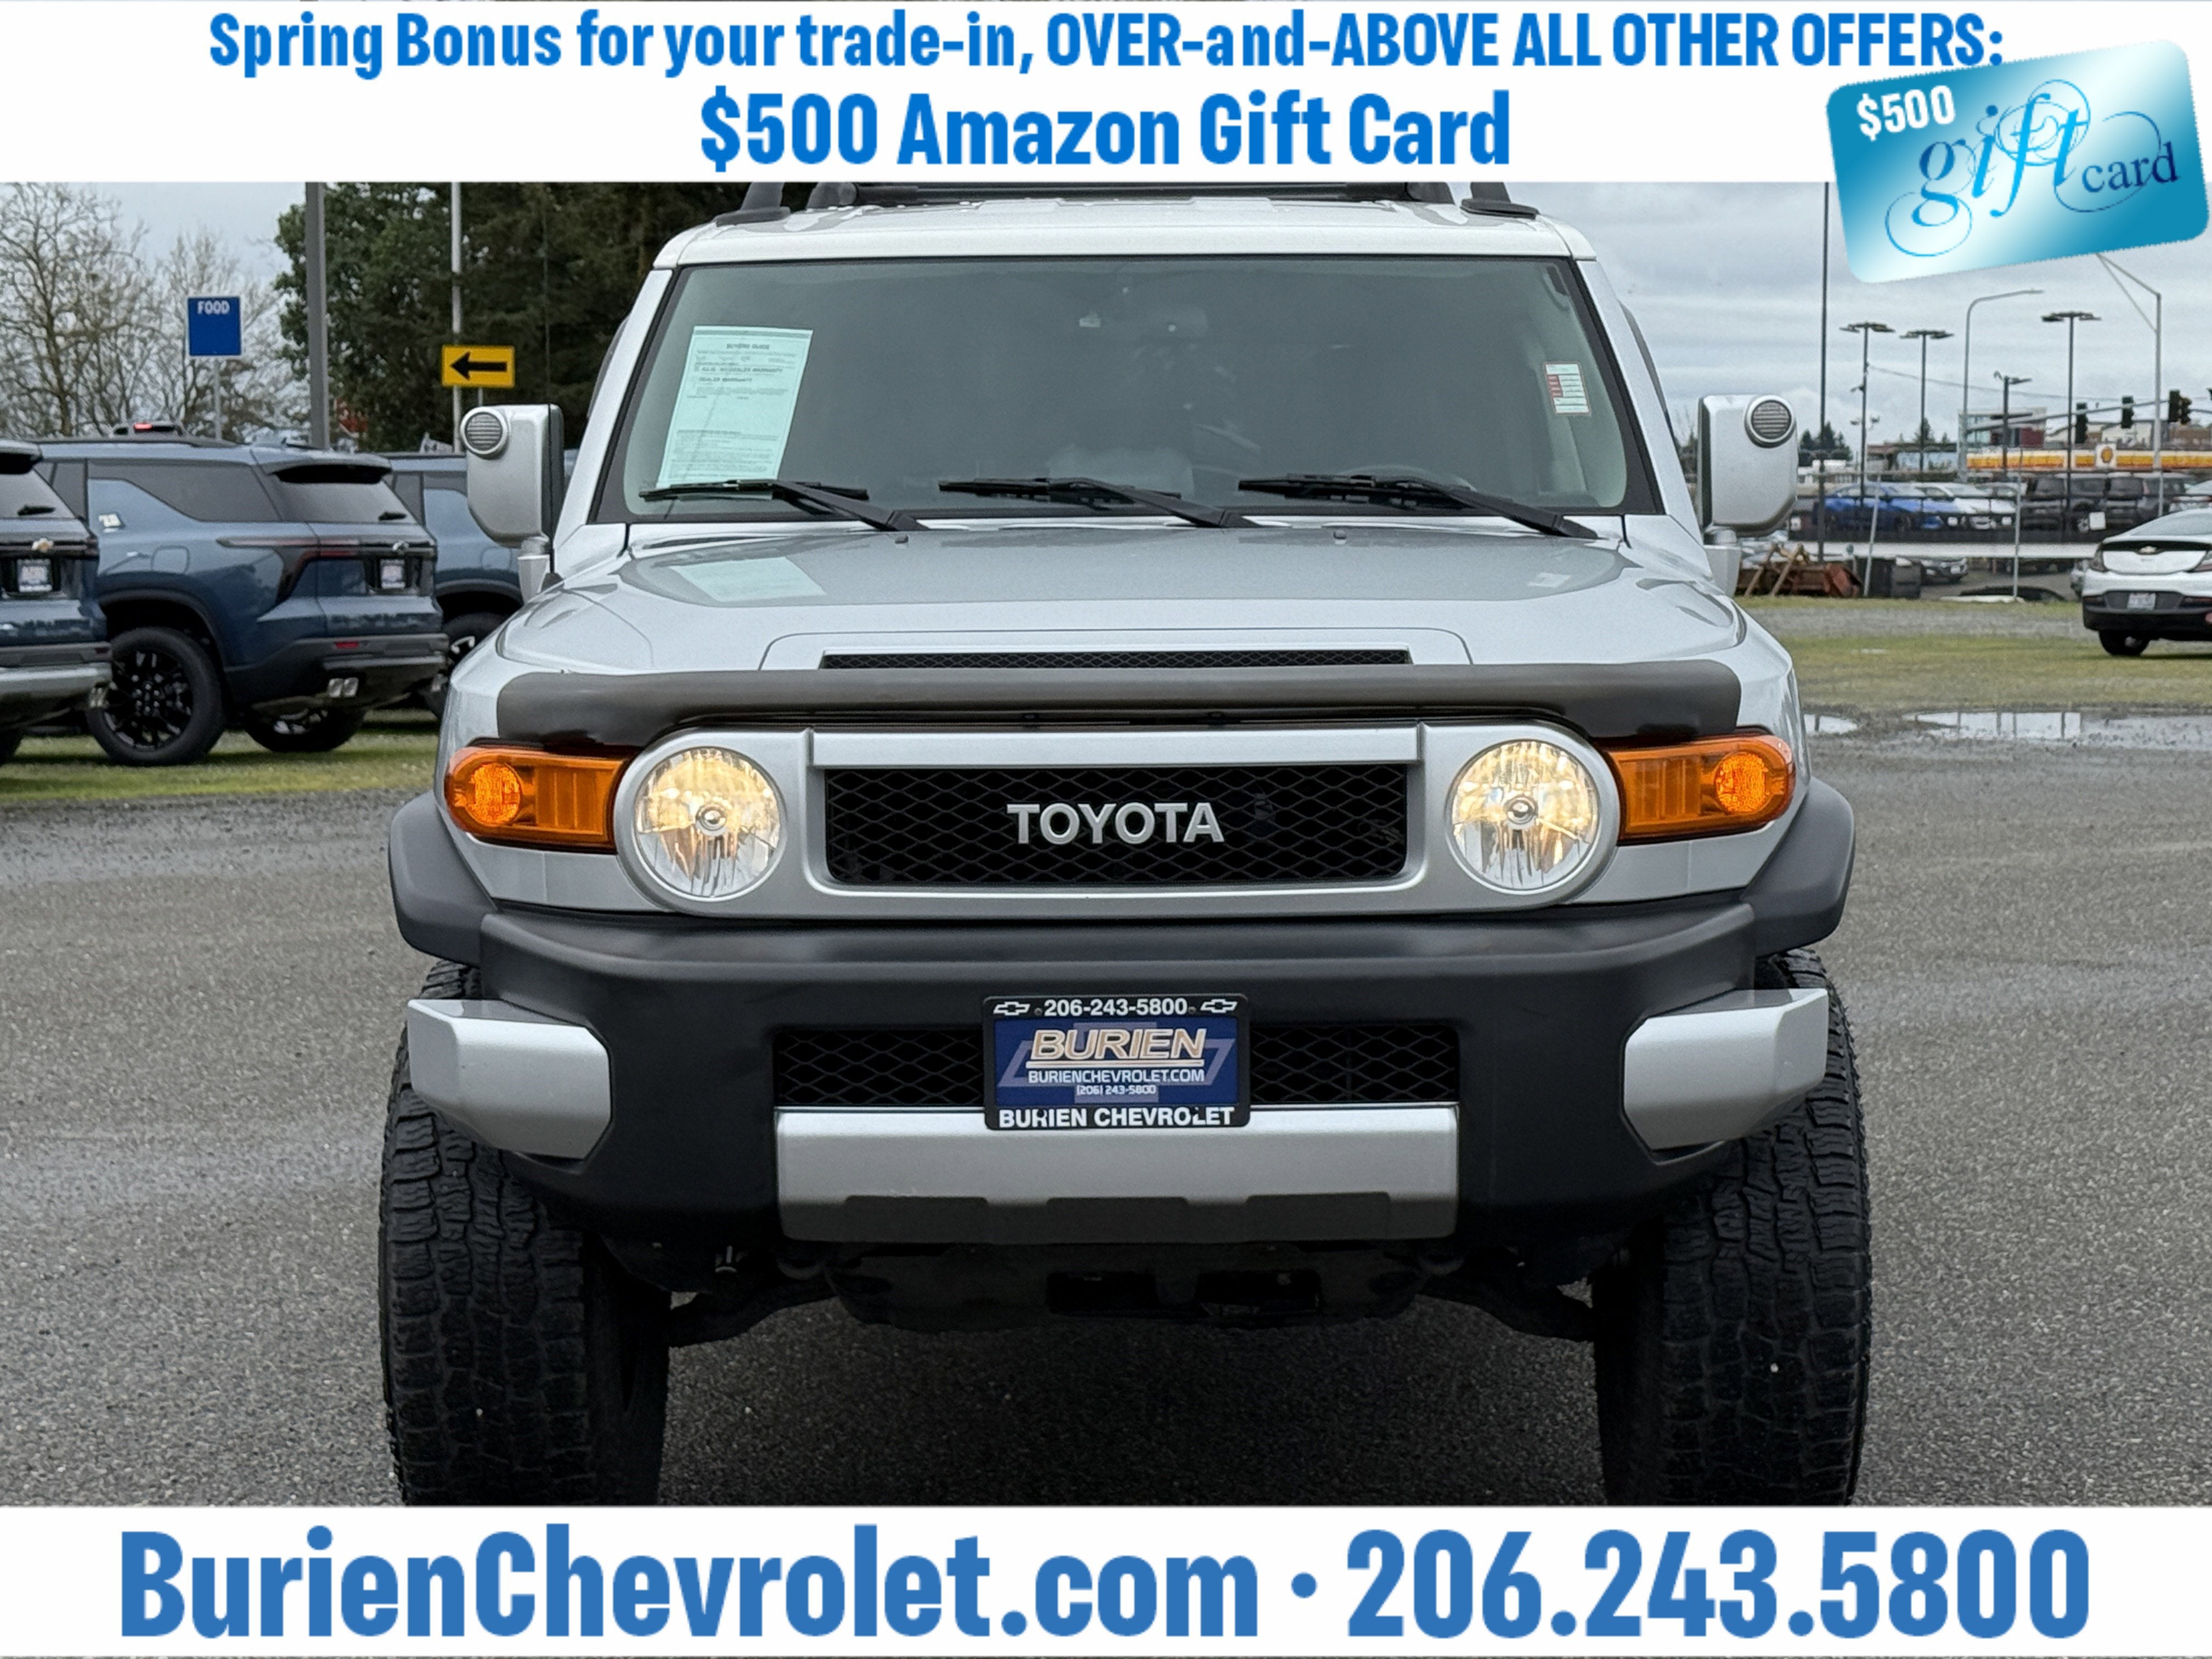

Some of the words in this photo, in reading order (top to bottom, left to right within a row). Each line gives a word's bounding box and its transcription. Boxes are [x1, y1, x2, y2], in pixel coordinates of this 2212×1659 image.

[197, 300, 230, 315] FOOD
[1006, 802, 1224, 845] TOYOTA
[1044, 998, 1188, 1017] 206-243-5800
[1030, 1028, 1206, 1060] BURIEN
[1028, 1069, 1205, 1084] BURIENCHEVROLET.COM
[1104, 1084, 1157, 1096] 243-5800
[999, 1108, 1087, 1128] BURIEN
